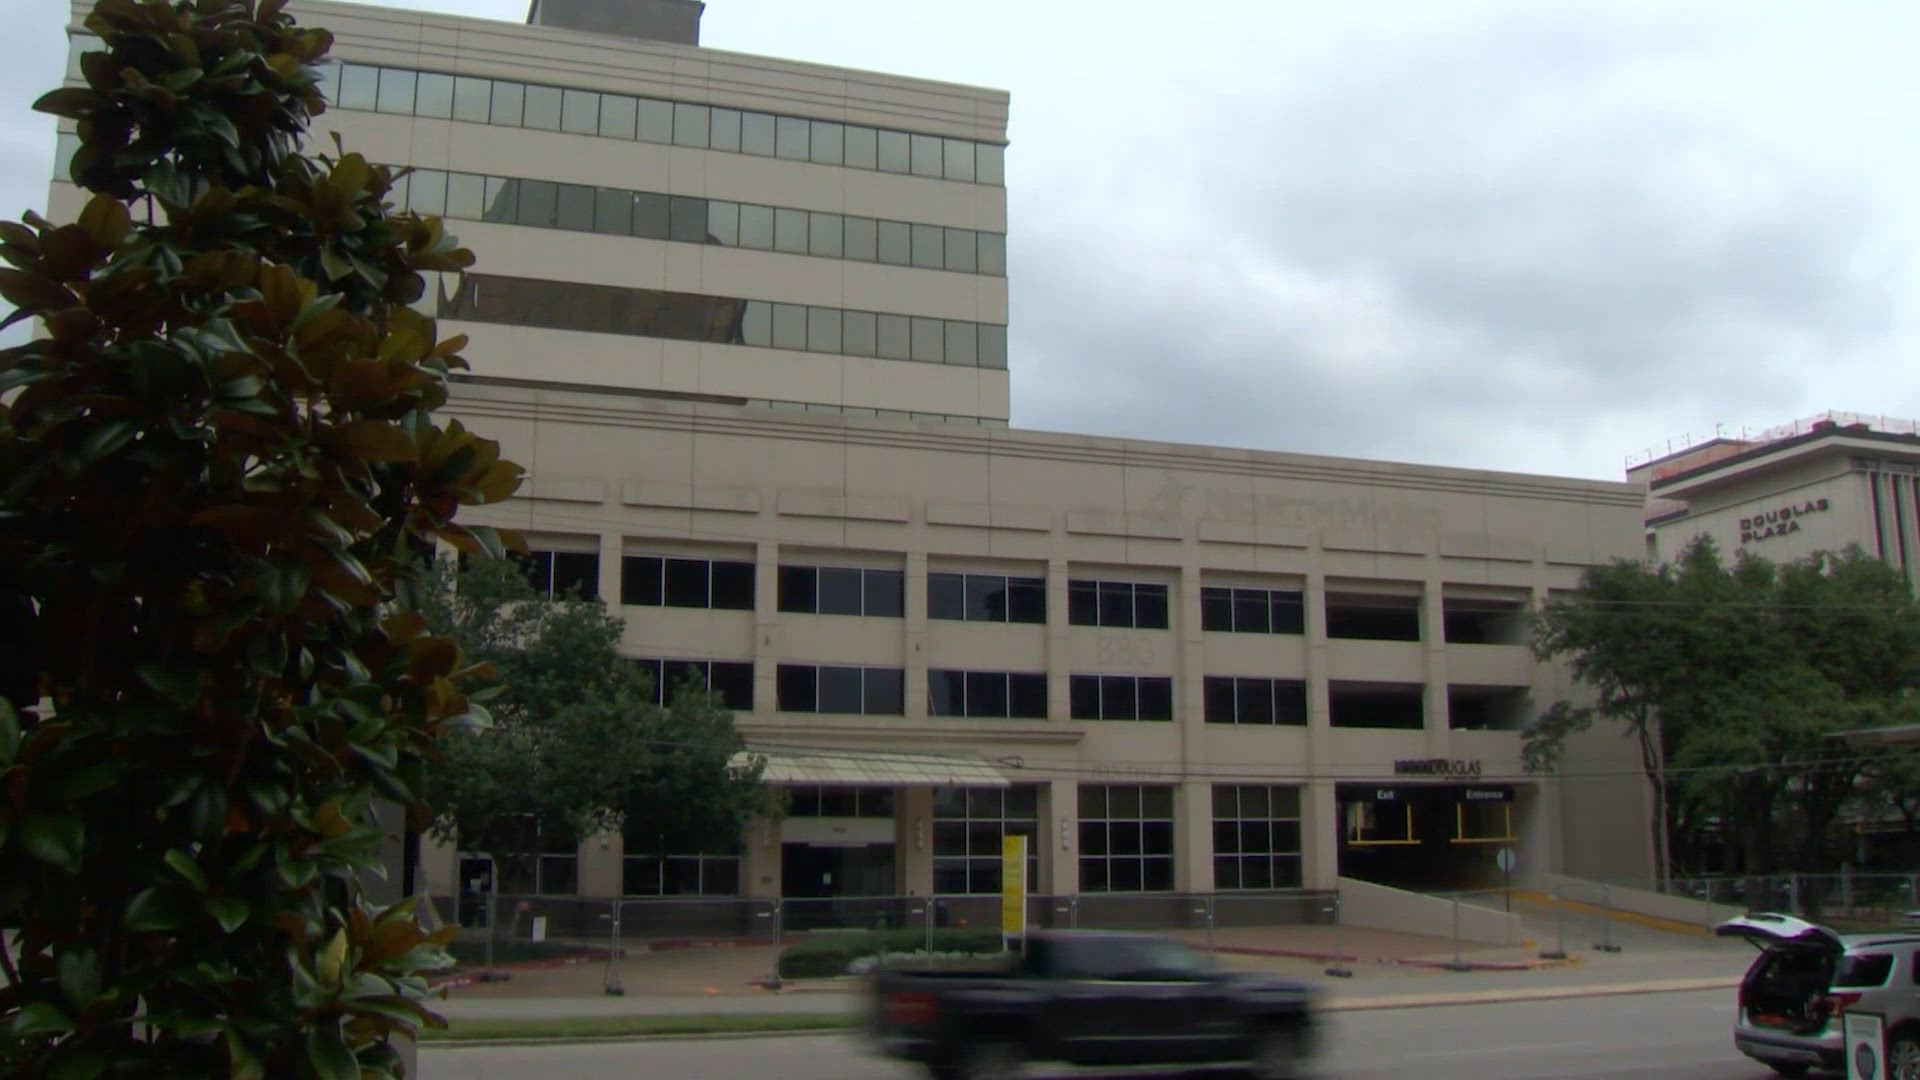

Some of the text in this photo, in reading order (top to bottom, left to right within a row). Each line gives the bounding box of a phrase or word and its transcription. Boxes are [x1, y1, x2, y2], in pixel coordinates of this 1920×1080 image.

[1740, 499, 1829, 530] DOUGLAS
[1741, 521, 1800, 544] PLAZA
[1376, 790, 1395, 799] Exit
[1465, 790, 1504, 799] Entrance
